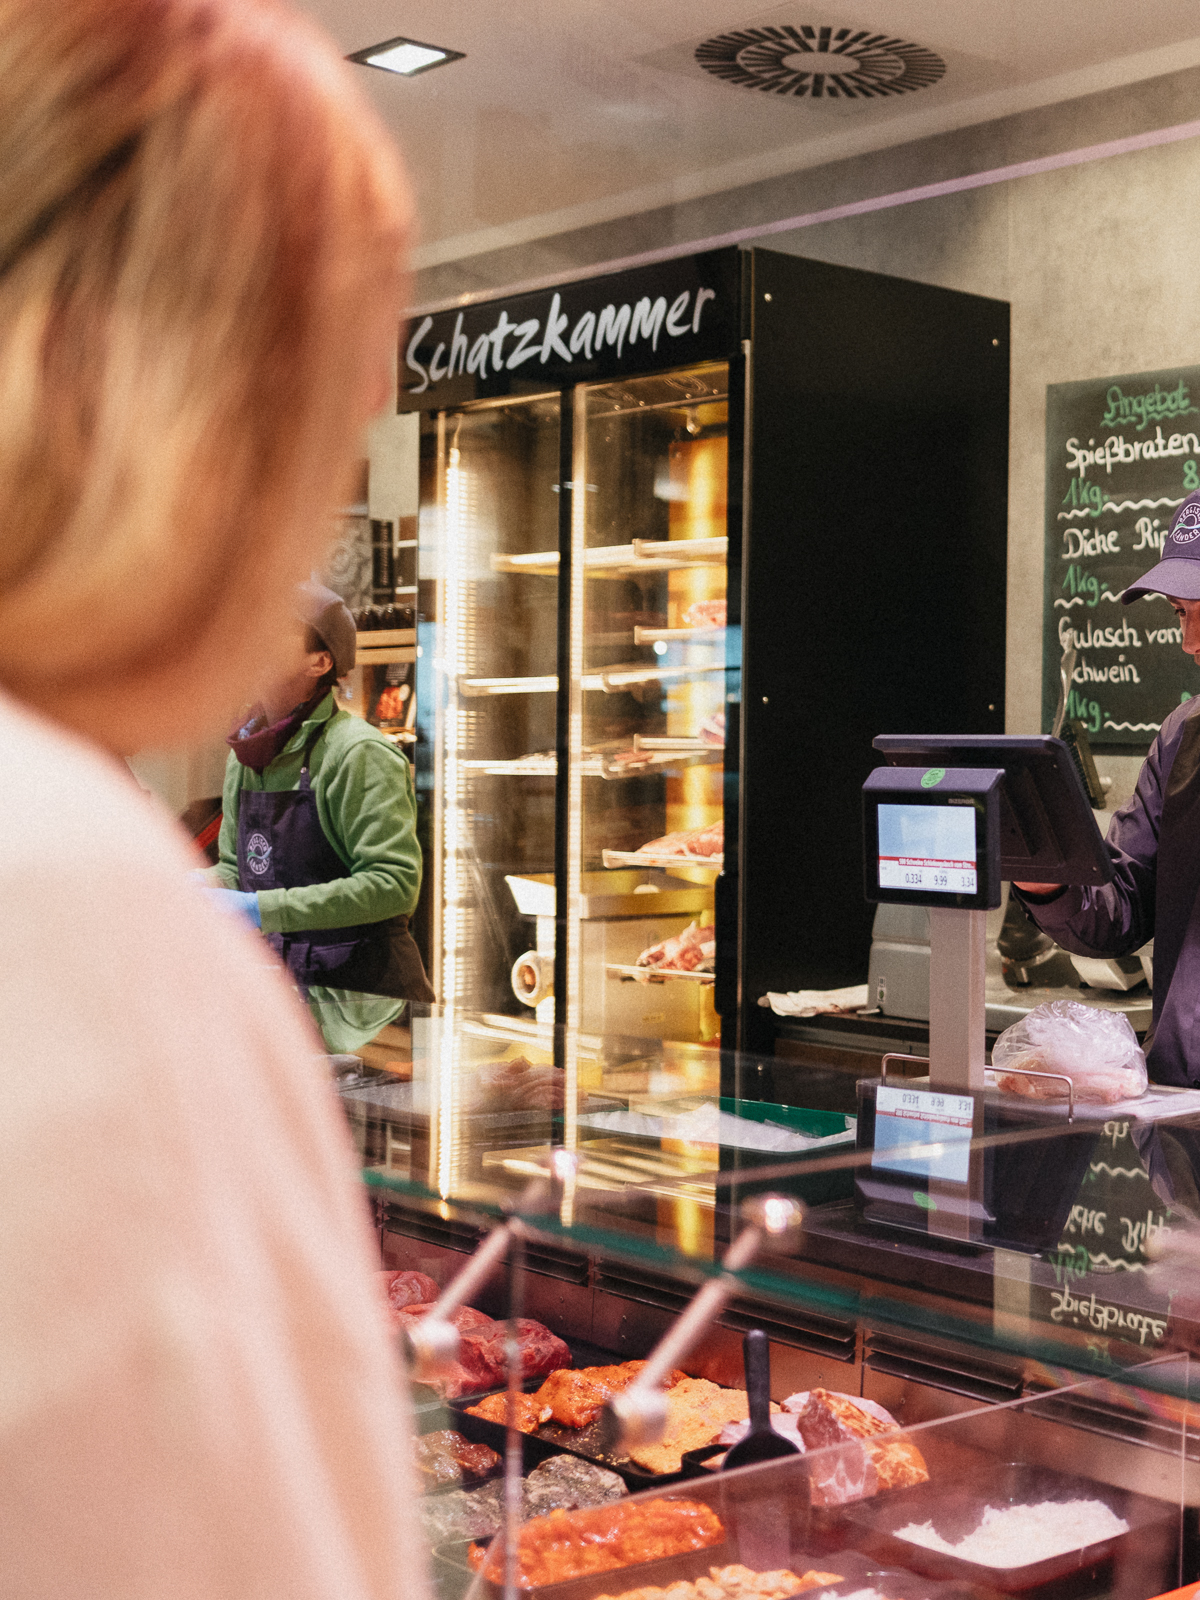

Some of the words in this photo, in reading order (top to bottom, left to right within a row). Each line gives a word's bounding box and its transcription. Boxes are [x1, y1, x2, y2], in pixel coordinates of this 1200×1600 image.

[406, 287, 716, 394] Schatzkammer
[1103, 380, 1191, 431] Angebot
[1071, 654, 1141, 683] chwein
